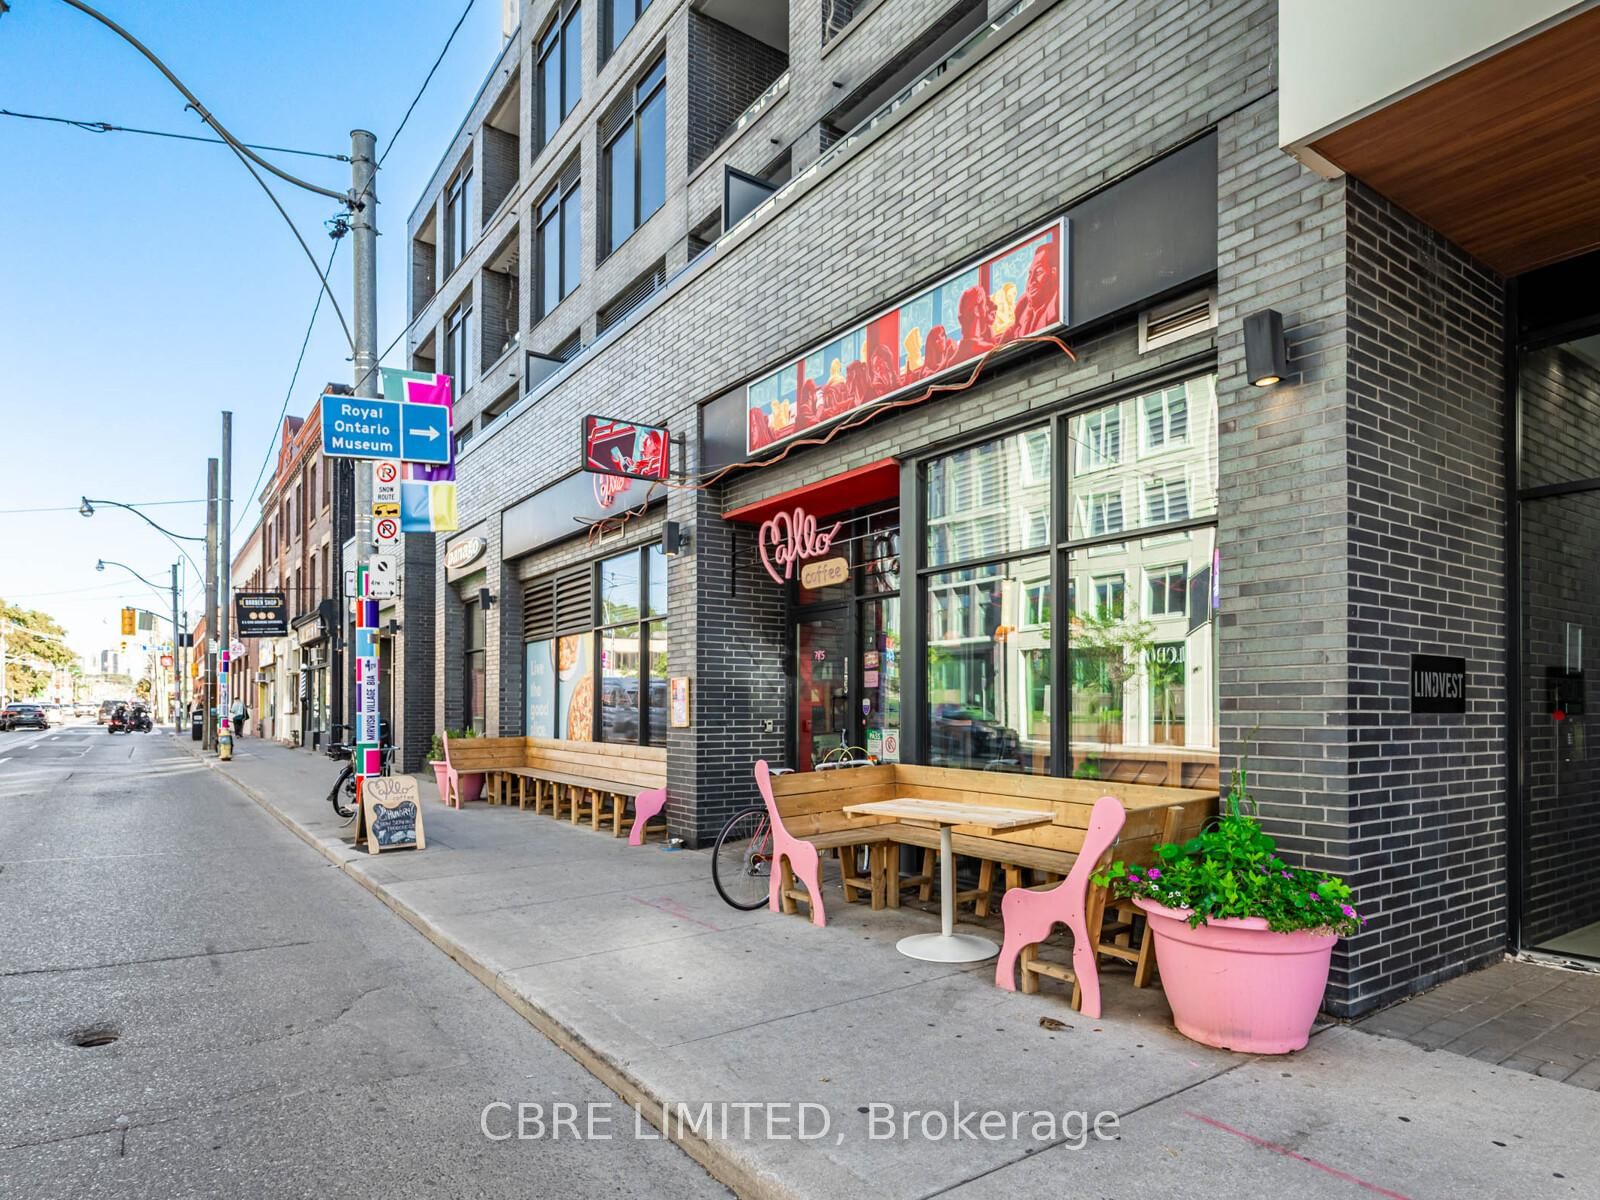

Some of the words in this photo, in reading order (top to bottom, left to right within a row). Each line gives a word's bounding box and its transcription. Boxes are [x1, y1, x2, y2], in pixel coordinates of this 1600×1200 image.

[341, 403, 383, 420] Royal
[334, 420, 390, 435] Ontario
[332, 436, 393, 452] Museum
[377, 493, 395, 501] ROUTE
[805, 564, 842, 585] coffee
[366, 675, 375, 686] BIA
[1414, 671, 1464, 699] LINDVEST
[366, 689, 375, 713] VILLAGE
[366, 715, 375, 741] MIRVISH
